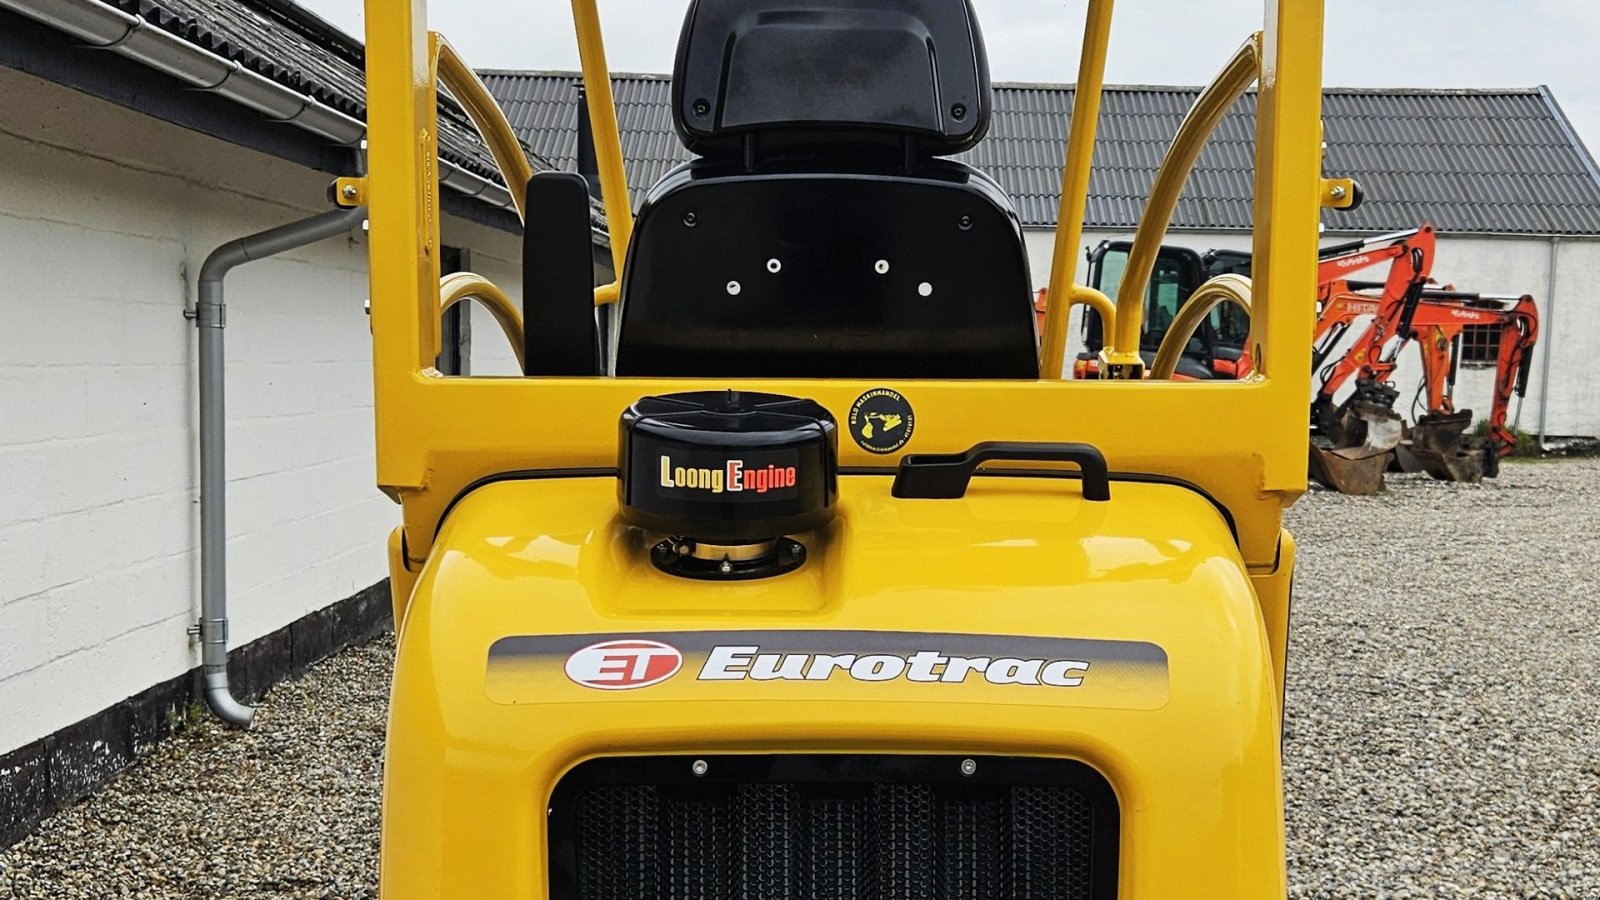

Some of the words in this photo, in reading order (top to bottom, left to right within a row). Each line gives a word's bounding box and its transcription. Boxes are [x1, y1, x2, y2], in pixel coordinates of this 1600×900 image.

[661, 455, 724, 493] Loong
[726, 460, 796, 493] Engine
[580, 645, 682, 683] ET
[696, 645, 1090, 687] Eurotrac
